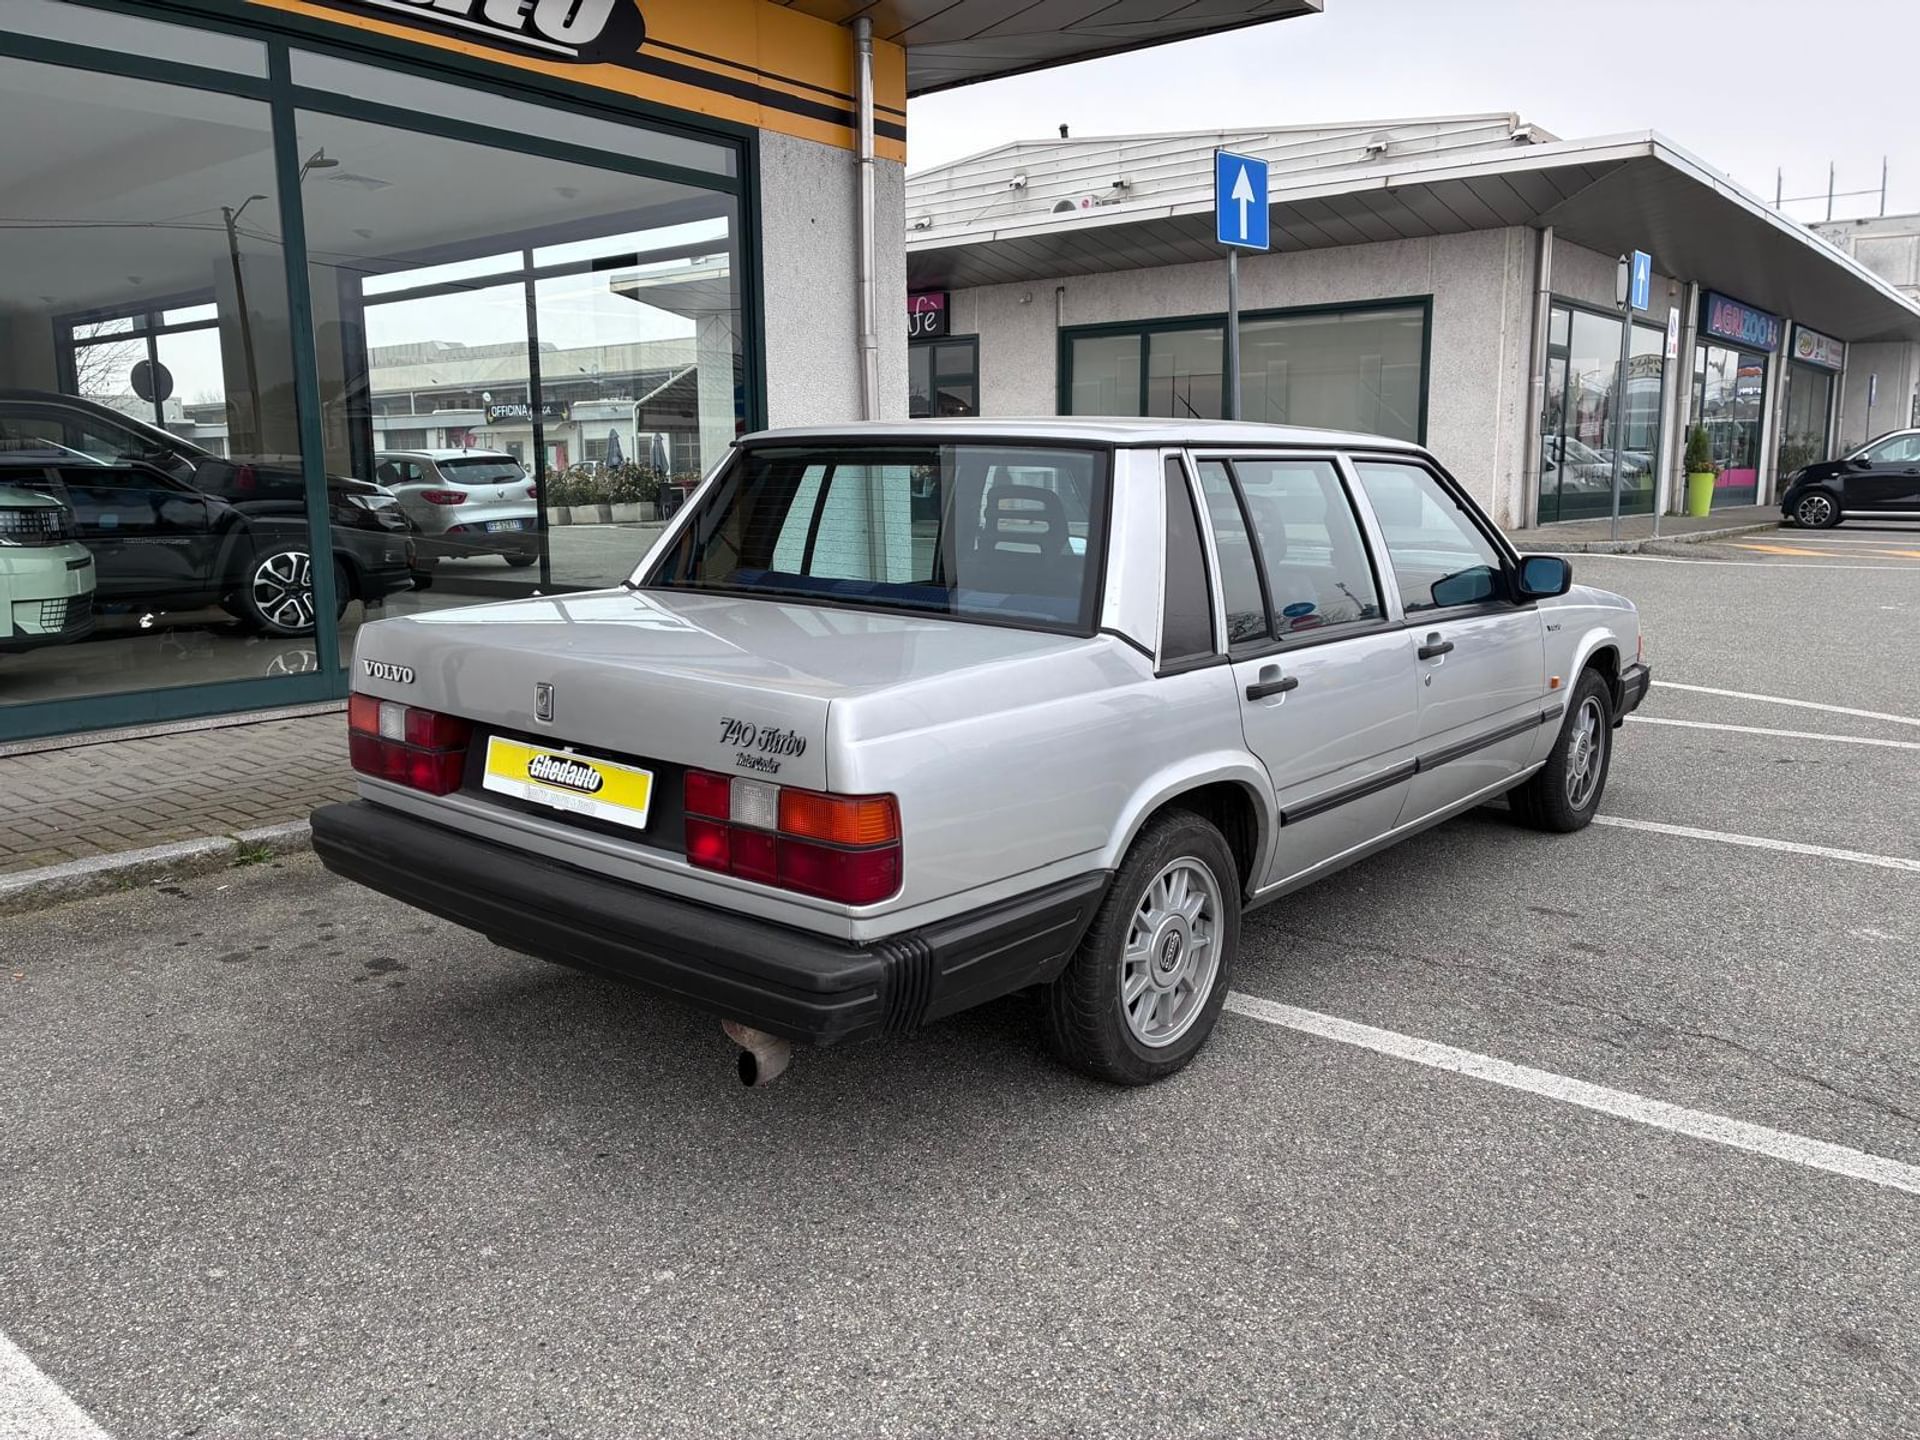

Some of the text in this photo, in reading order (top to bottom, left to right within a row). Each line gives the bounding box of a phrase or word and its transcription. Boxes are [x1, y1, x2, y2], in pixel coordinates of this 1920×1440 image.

[361, 659, 415, 684] VOLVO
[720, 716, 807, 757] 740 Turbo
[530, 754, 602, 791] Ghedauto
